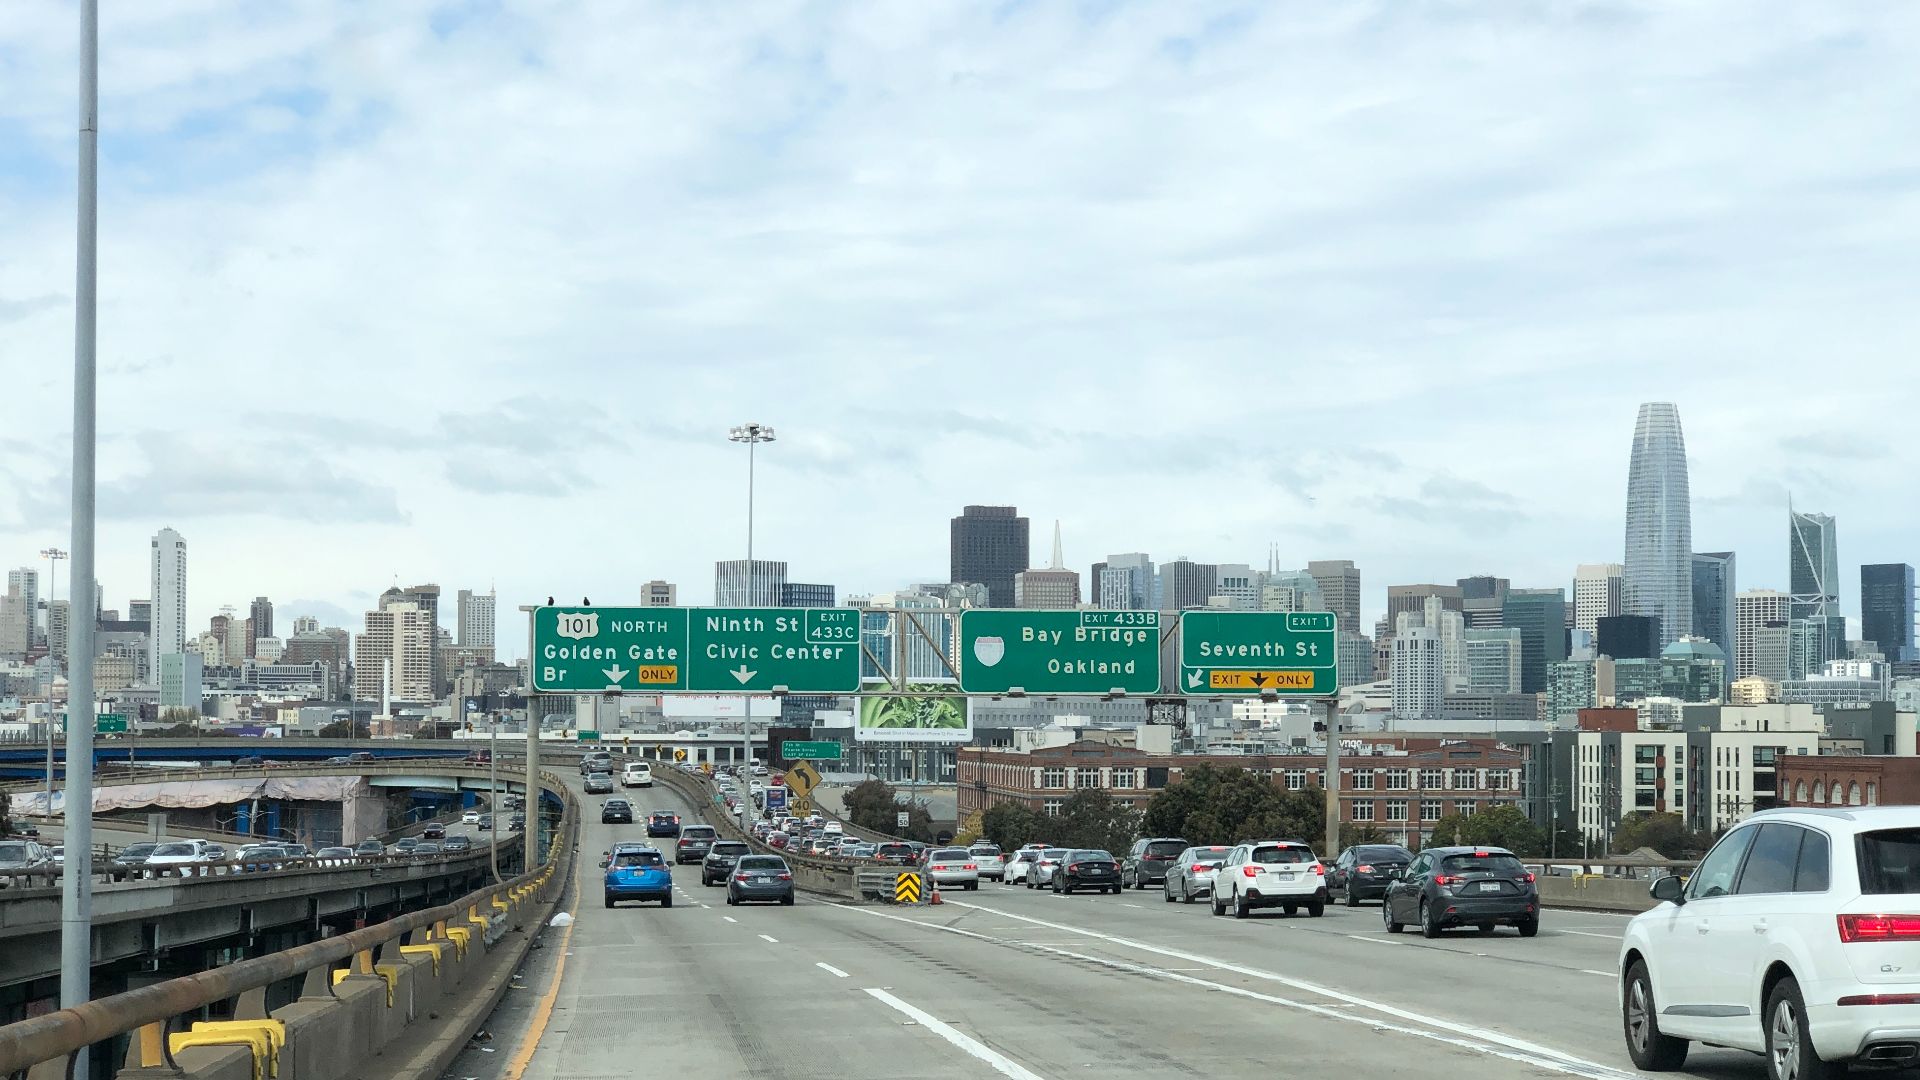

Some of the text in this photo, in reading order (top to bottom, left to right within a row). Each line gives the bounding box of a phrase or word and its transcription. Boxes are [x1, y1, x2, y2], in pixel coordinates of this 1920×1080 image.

[820, 613, 847, 622] EXIT
[1084, 613, 1156, 625] EXIT 433B
[1292, 617, 1330, 626] EXIT 1
[564, 618, 593, 634] 101
[611, 621, 668, 633] NORTH
[706, 616, 799, 632] Ninth St
[811, 627, 854, 639] 433C
[1021, 627, 1147, 645] Bay Bridge
[544, 645, 678, 660] Golden Gate
[706, 644, 843, 660] Civic Center
[1199, 641, 1318, 657] Seventh St
[1047, 658, 1136, 674] Oakland
[543, 667, 567, 682] Br
[640, 669, 676, 681] ONLY
[1212, 674, 1311, 685] EXIT ONLY
[794, 800, 810, 811] 40
[1880, 964, 1902, 973] Q7
